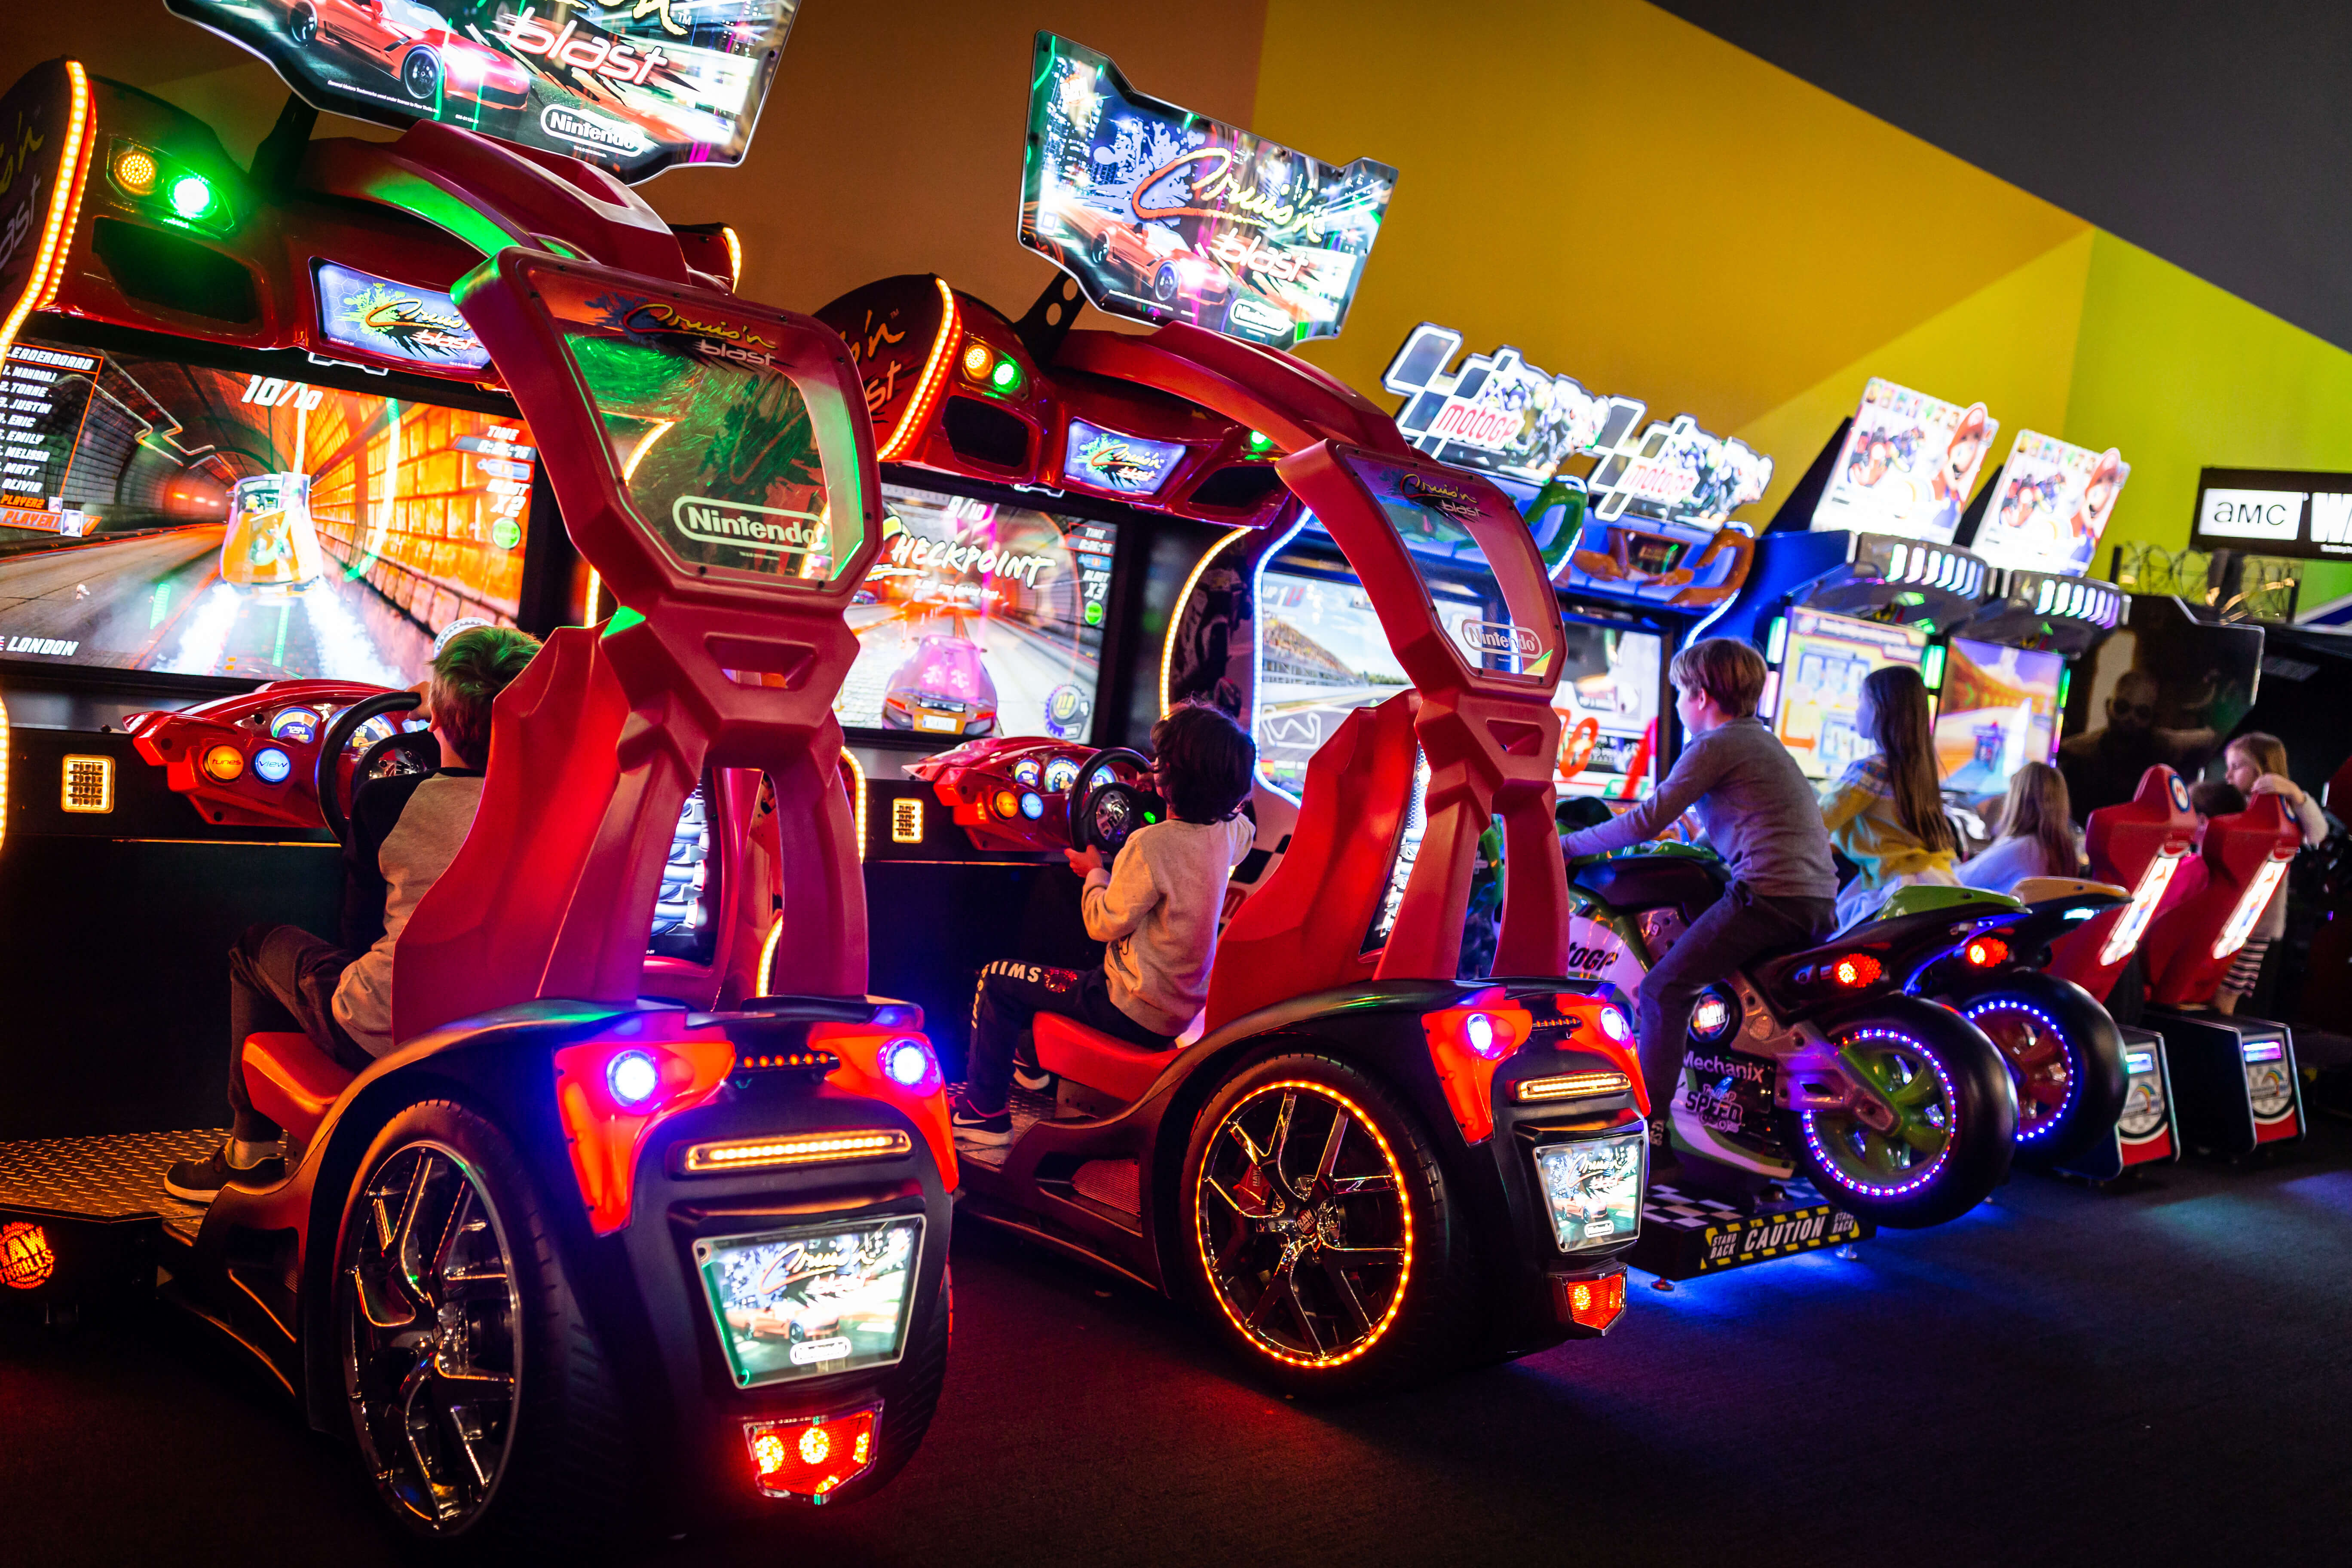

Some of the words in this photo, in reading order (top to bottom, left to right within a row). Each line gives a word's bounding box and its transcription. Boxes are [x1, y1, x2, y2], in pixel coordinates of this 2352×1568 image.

[505, 6, 668, 85] blast
[550, 111, 637, 150] Nintendo
[1132, 147, 1322, 243] Cruis'n
[1211, 227, 1311, 283] blast
[623, 303, 777, 349] Cruis'n
[409, 329, 478, 350] blast
[695, 339, 775, 366] blast
[241, 374, 324, 411] 10/10
[9, 398, 52, 414] JUSTIN
[7, 414, 37, 428] ERIC
[487, 425, 519, 441] TIME
[6, 430, 45, 445] EMILY
[4, 446, 51, 462] MELISSA
[1091, 443, 1161, 469] Cruis'n
[3, 462, 40, 476] MATT
[1, 478, 43, 493] OLIVIA
[1400, 473, 1479, 503] Cruis'n
[0, 494, 46, 509] PLAYER2
[489, 494, 527, 518] X2
[1439, 499, 1481, 518] blast
[1, 510, 61, 528] PLAYER1
[688, 505, 824, 546] Nintendo
[2310, 492, 2352, 544] W
[6, 636, 80, 656] LONDON
[1683, 1050, 1764, 1084] Mechanix
[1685, 1090, 1742, 1125] SPEED
[1744, 1216, 1826, 1252] CAUTION
[1832, 1219, 1854, 1234] BACK
[1709, 1243, 1736, 1260] BACK
[1712, 1232, 1737, 1247] STAND
[758, 1242, 876, 1295] Cruis'n
